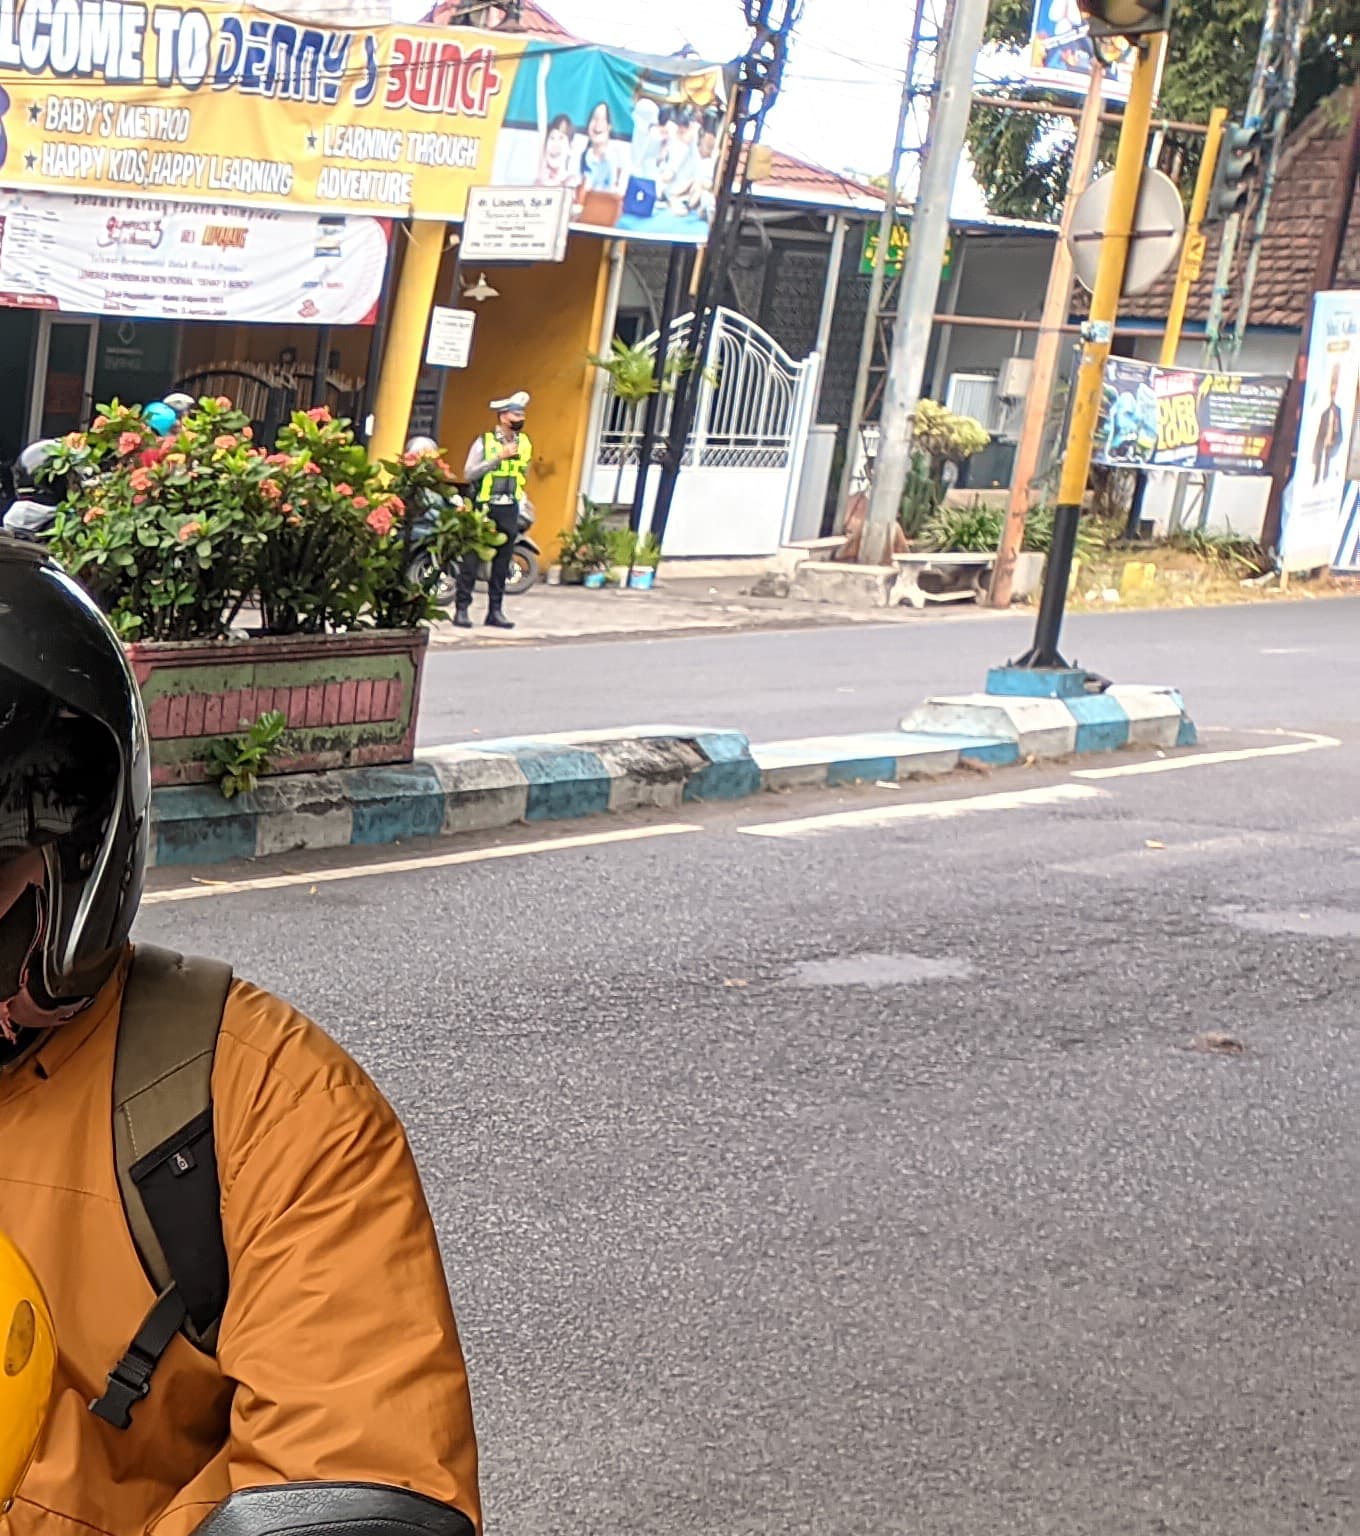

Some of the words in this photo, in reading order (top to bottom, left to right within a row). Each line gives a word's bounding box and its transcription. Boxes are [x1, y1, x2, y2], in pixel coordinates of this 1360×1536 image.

[152, 5, 211, 90] TO
[45, 95, 114, 138] BABY'S
[116, 104, 191, 142] METHOD
[41, 141, 108, 180] HAPPY
[209, 156, 294, 195] LEARNING
[323, 123, 403, 163] LEARNING
[406, 130, 481, 169] THROUGH
[316, 165, 414, 204] ADVENTURE
